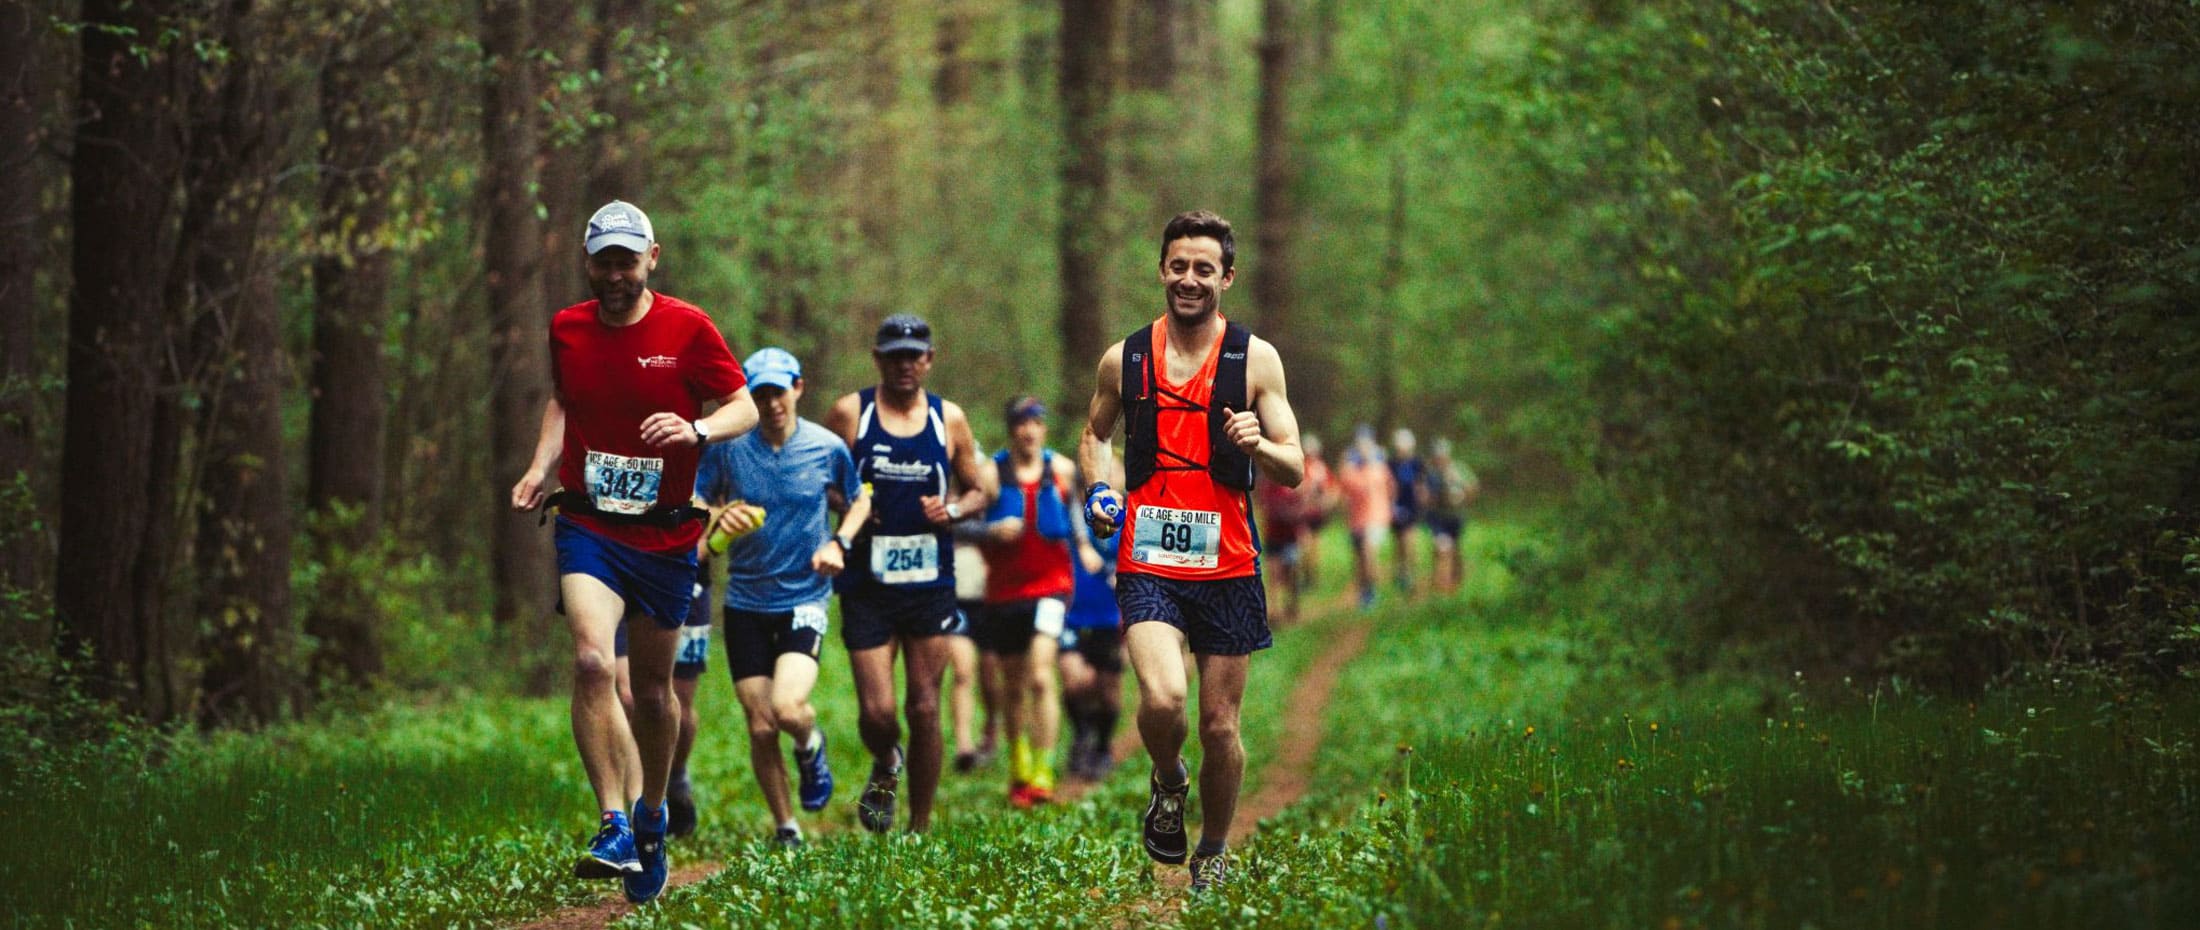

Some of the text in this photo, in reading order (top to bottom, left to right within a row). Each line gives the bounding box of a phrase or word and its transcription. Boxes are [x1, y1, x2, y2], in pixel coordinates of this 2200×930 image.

[589, 452, 602, 465] ICE
[604, 455, 619, 468] AGE
[627, 458, 639, 469] 50
[640, 459, 661, 471] MILE
[600, 468, 645, 500] 342
[1141, 507, 1154, 518] ICE
[1156, 509, 1173, 521] AGE
[1181, 511, 1193, 523] 50
[1195, 512, 1216, 524] MILE
[1161, 522, 1191, 553] 69
[887, 547, 923, 571] 254
